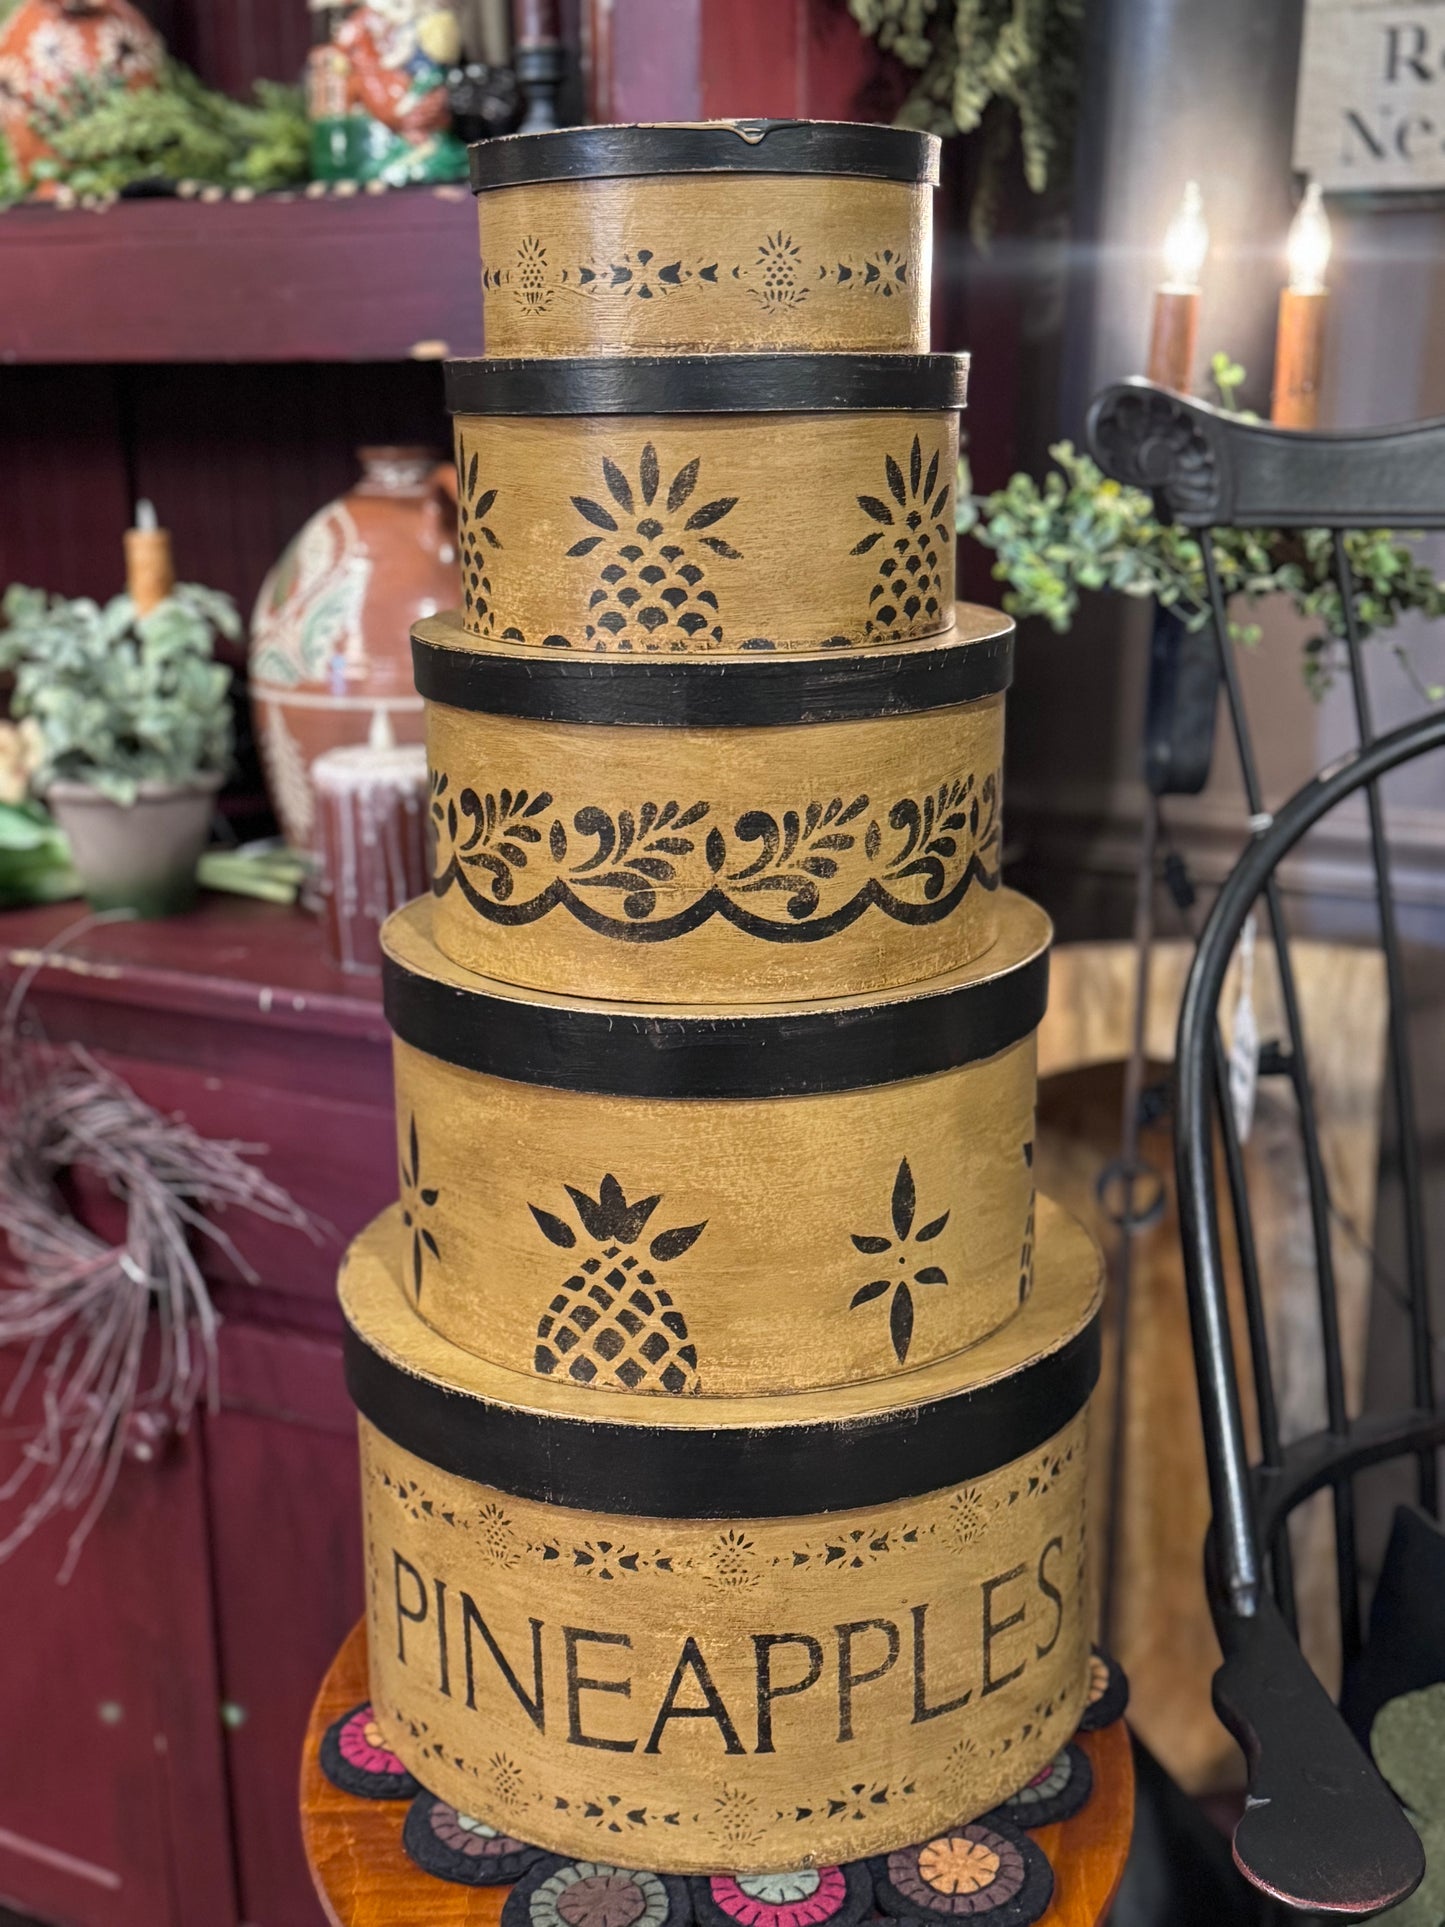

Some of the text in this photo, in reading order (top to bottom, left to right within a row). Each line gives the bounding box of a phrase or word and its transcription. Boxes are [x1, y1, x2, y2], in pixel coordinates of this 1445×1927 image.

[1384, 22, 1445, 84] R
[1341, 104, 1445, 165] Ne
[393, 1536, 1063, 1755] PINEAPPLES
